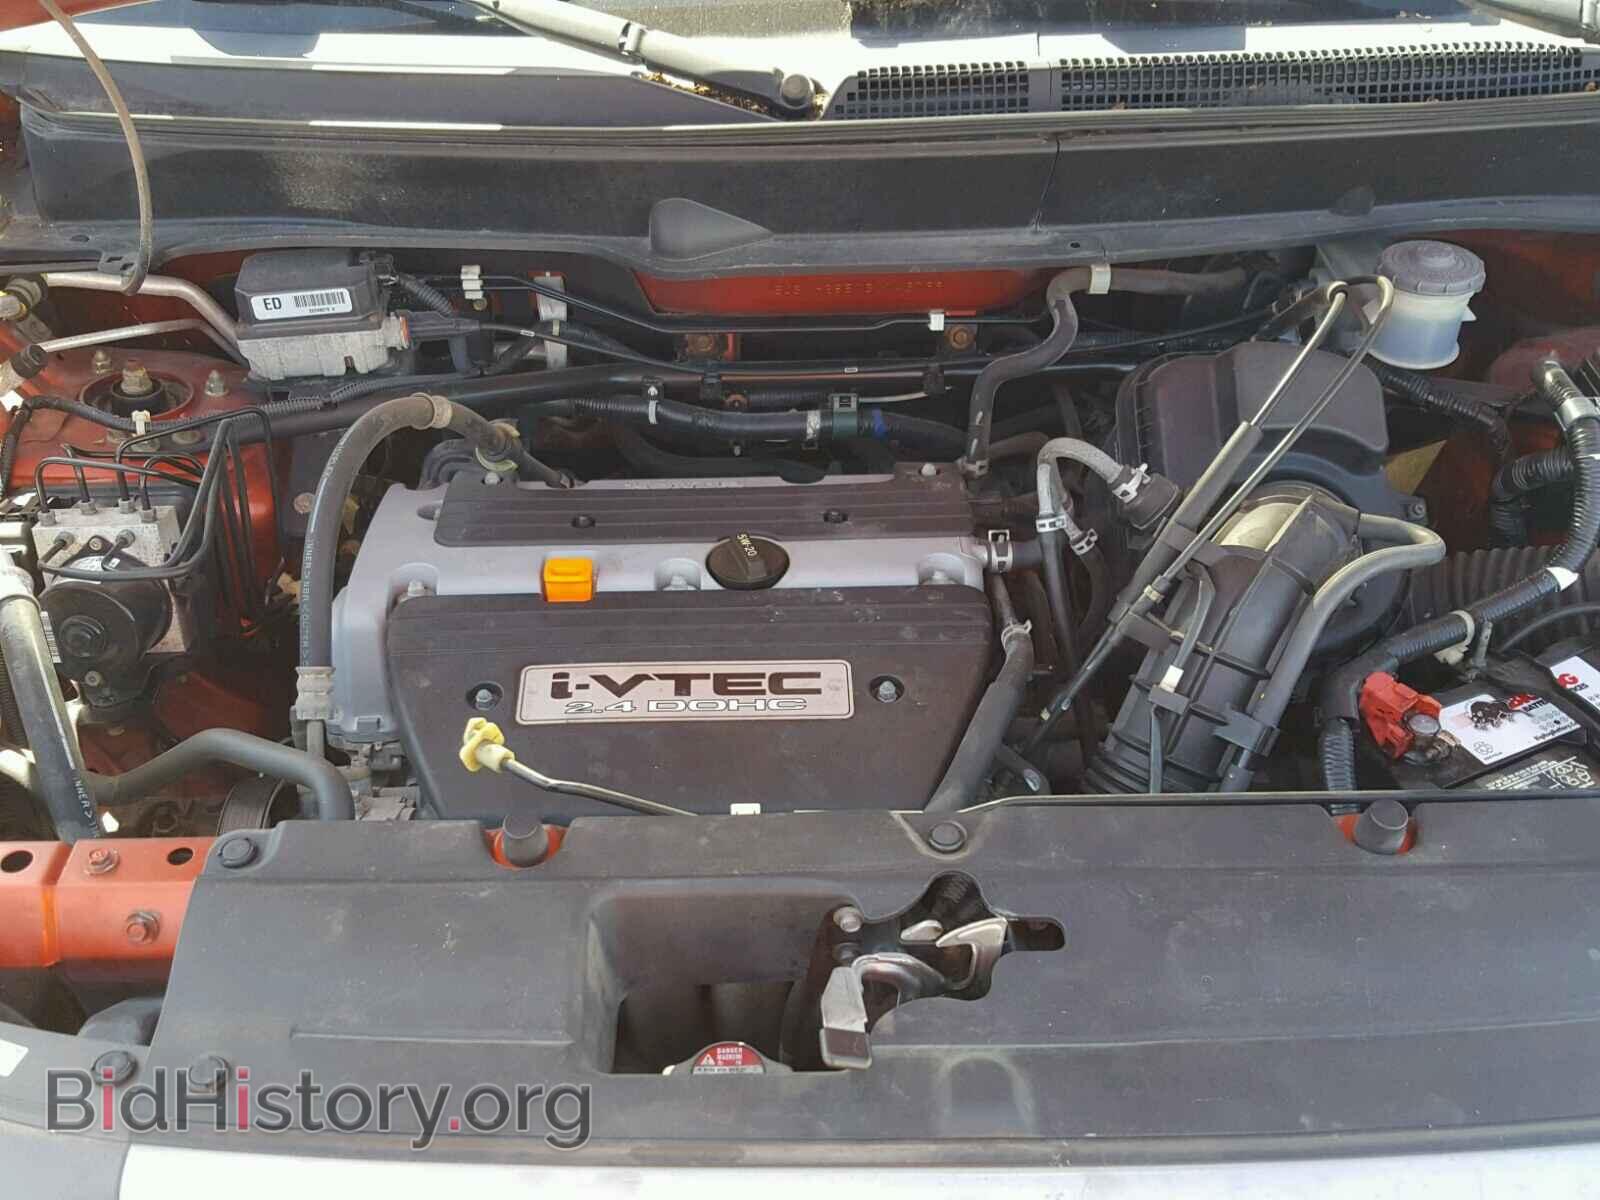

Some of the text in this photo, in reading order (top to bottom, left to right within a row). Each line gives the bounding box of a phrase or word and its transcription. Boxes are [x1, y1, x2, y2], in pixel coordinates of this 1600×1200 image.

[263, 297, 282, 311] ED
[736, 533, 758, 557] 5W-20
[551, 671, 822, 700] i-VTEC
[564, 698, 807, 715] 2.4 DOHC
